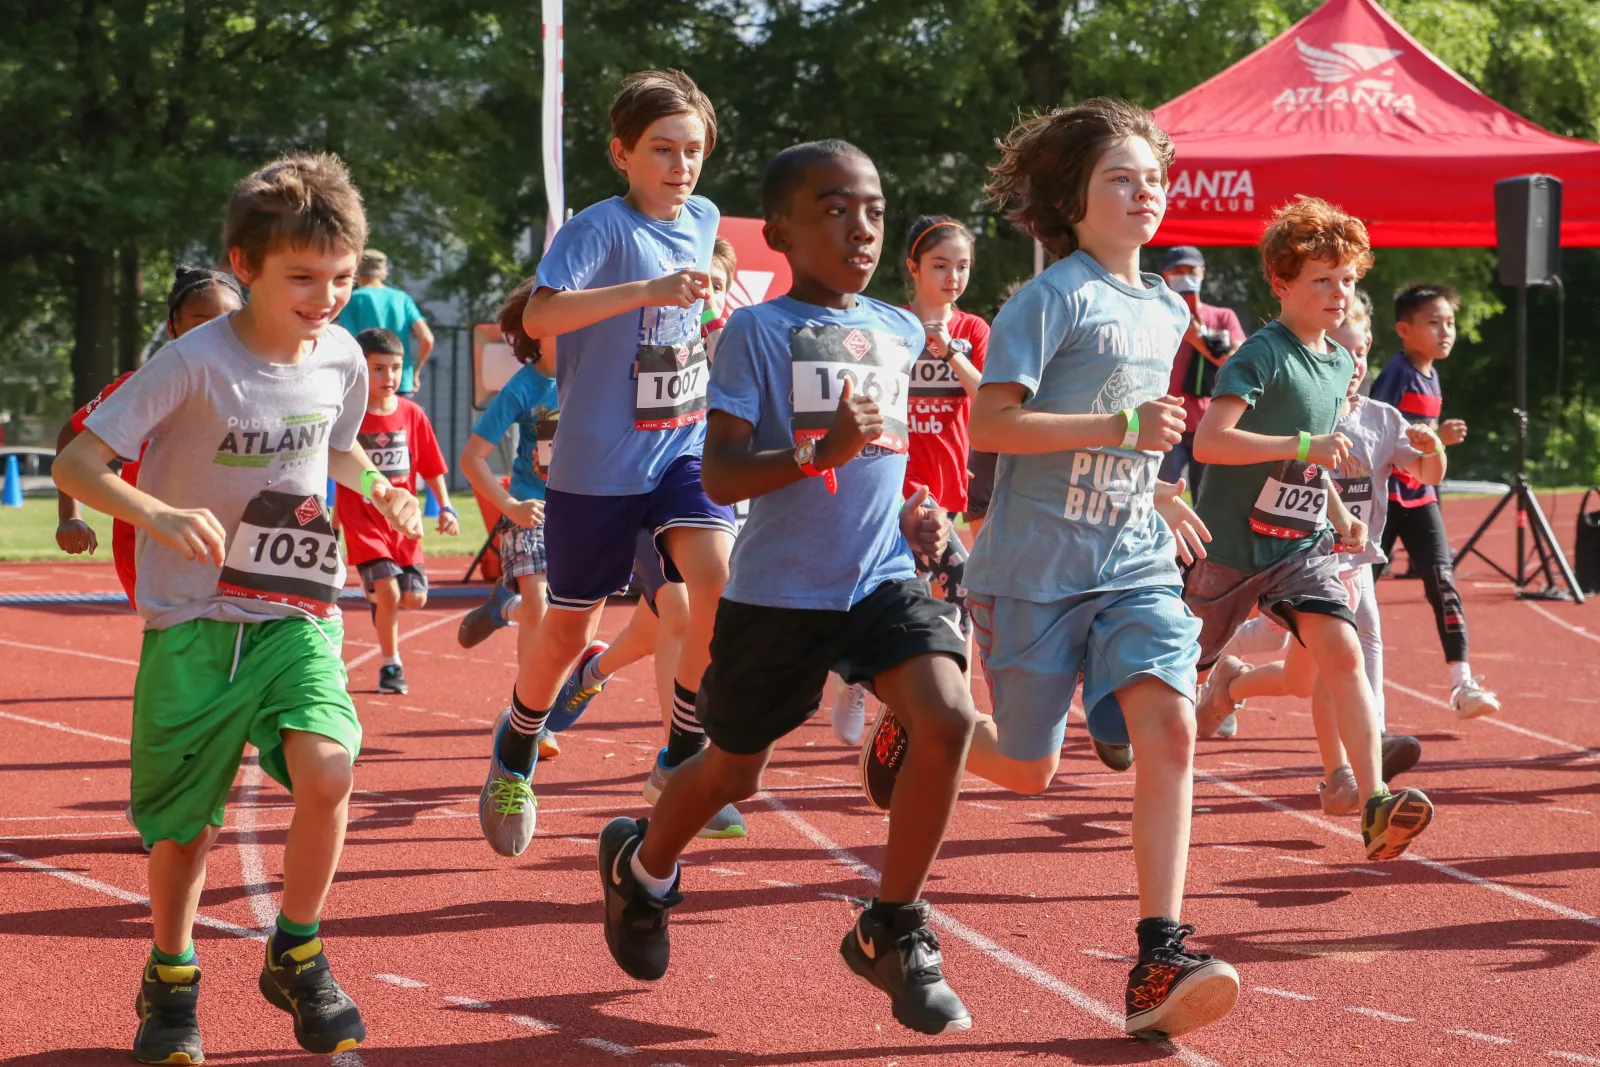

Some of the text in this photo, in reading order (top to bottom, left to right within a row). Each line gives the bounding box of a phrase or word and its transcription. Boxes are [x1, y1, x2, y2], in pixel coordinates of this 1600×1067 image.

[1272, 85, 1417, 117] ATLANTA
[1166, 170, 1255, 198] ANTA
[1200, 198, 1255, 212] CLUB
[1098, 326, 1129, 355] I'M
[653, 366, 701, 400] 1007
[366, 451, 404, 466] 027
[1274, 487, 1325, 514] 1029
[1348, 484, 1369, 493] MILE
[254, 533, 339, 575] 1035
